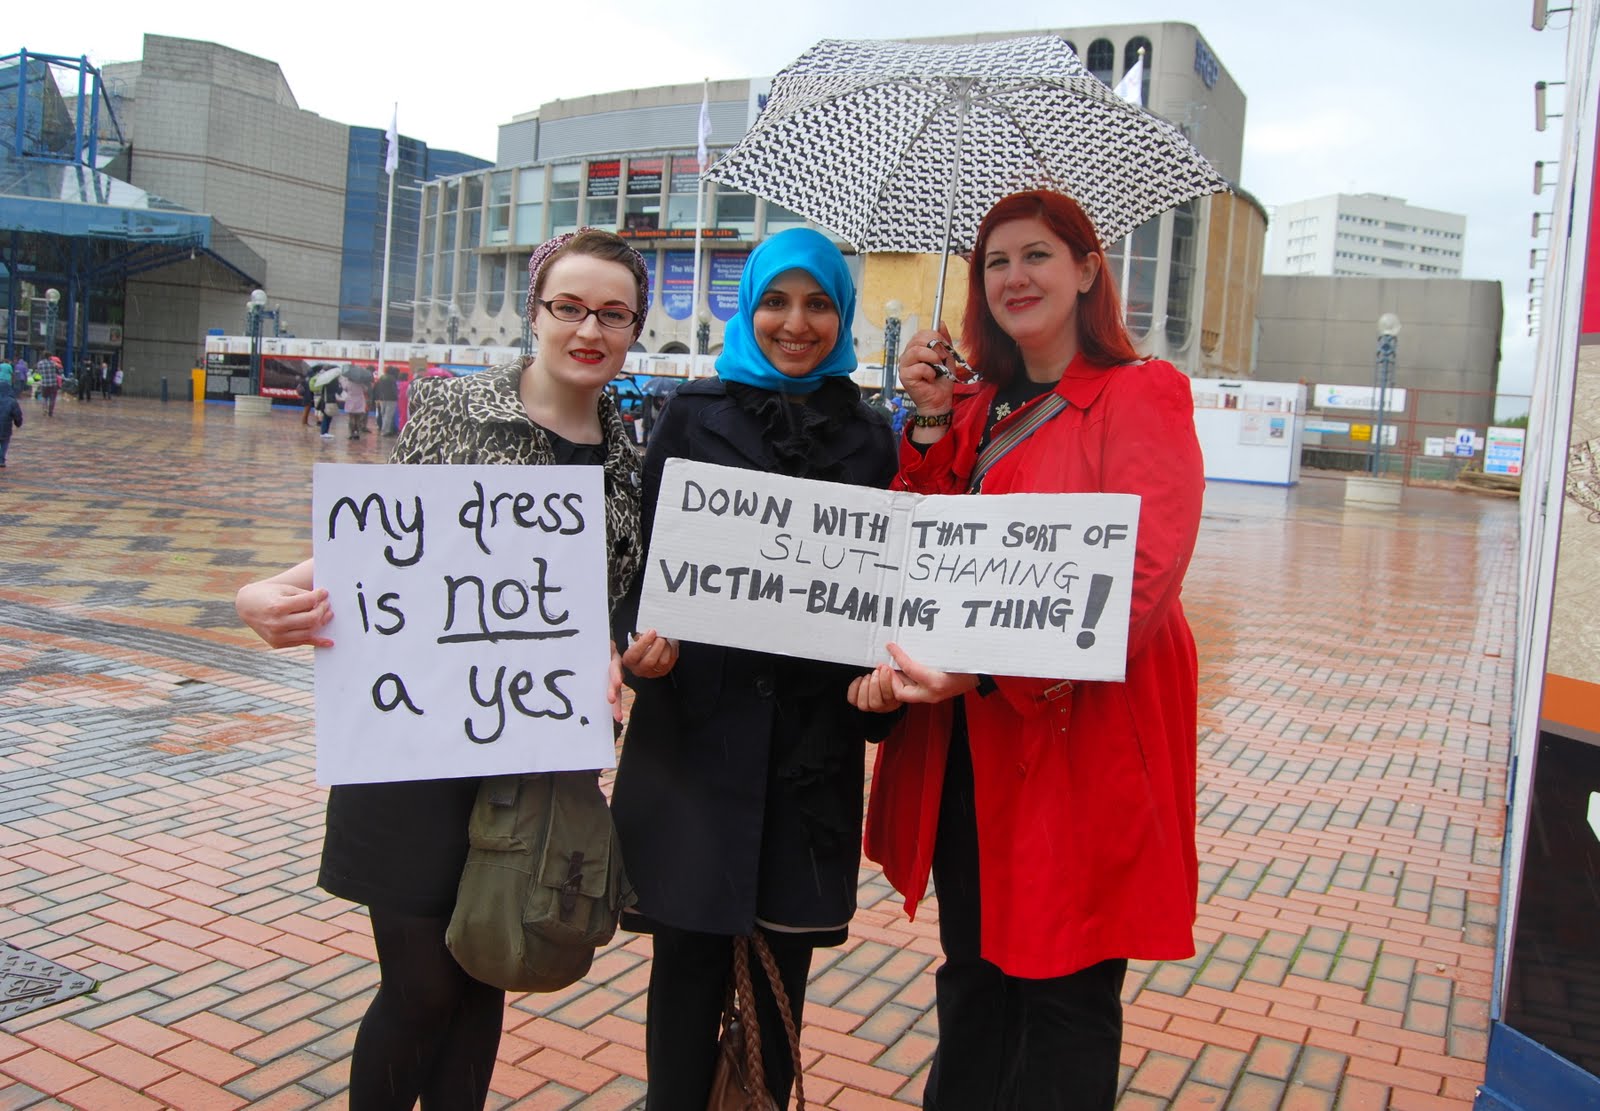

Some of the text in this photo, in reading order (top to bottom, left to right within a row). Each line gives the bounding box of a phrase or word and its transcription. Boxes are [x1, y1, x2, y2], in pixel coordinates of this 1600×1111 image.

[459, 480, 585, 555] dress
[682, 480, 1128, 553] DOWN WITH THAT SORT OF
[356, 557, 569, 643] is not
[659, 558, 940, 631] VICTIM-BLAMING
[372, 665, 589, 744] a yes.
